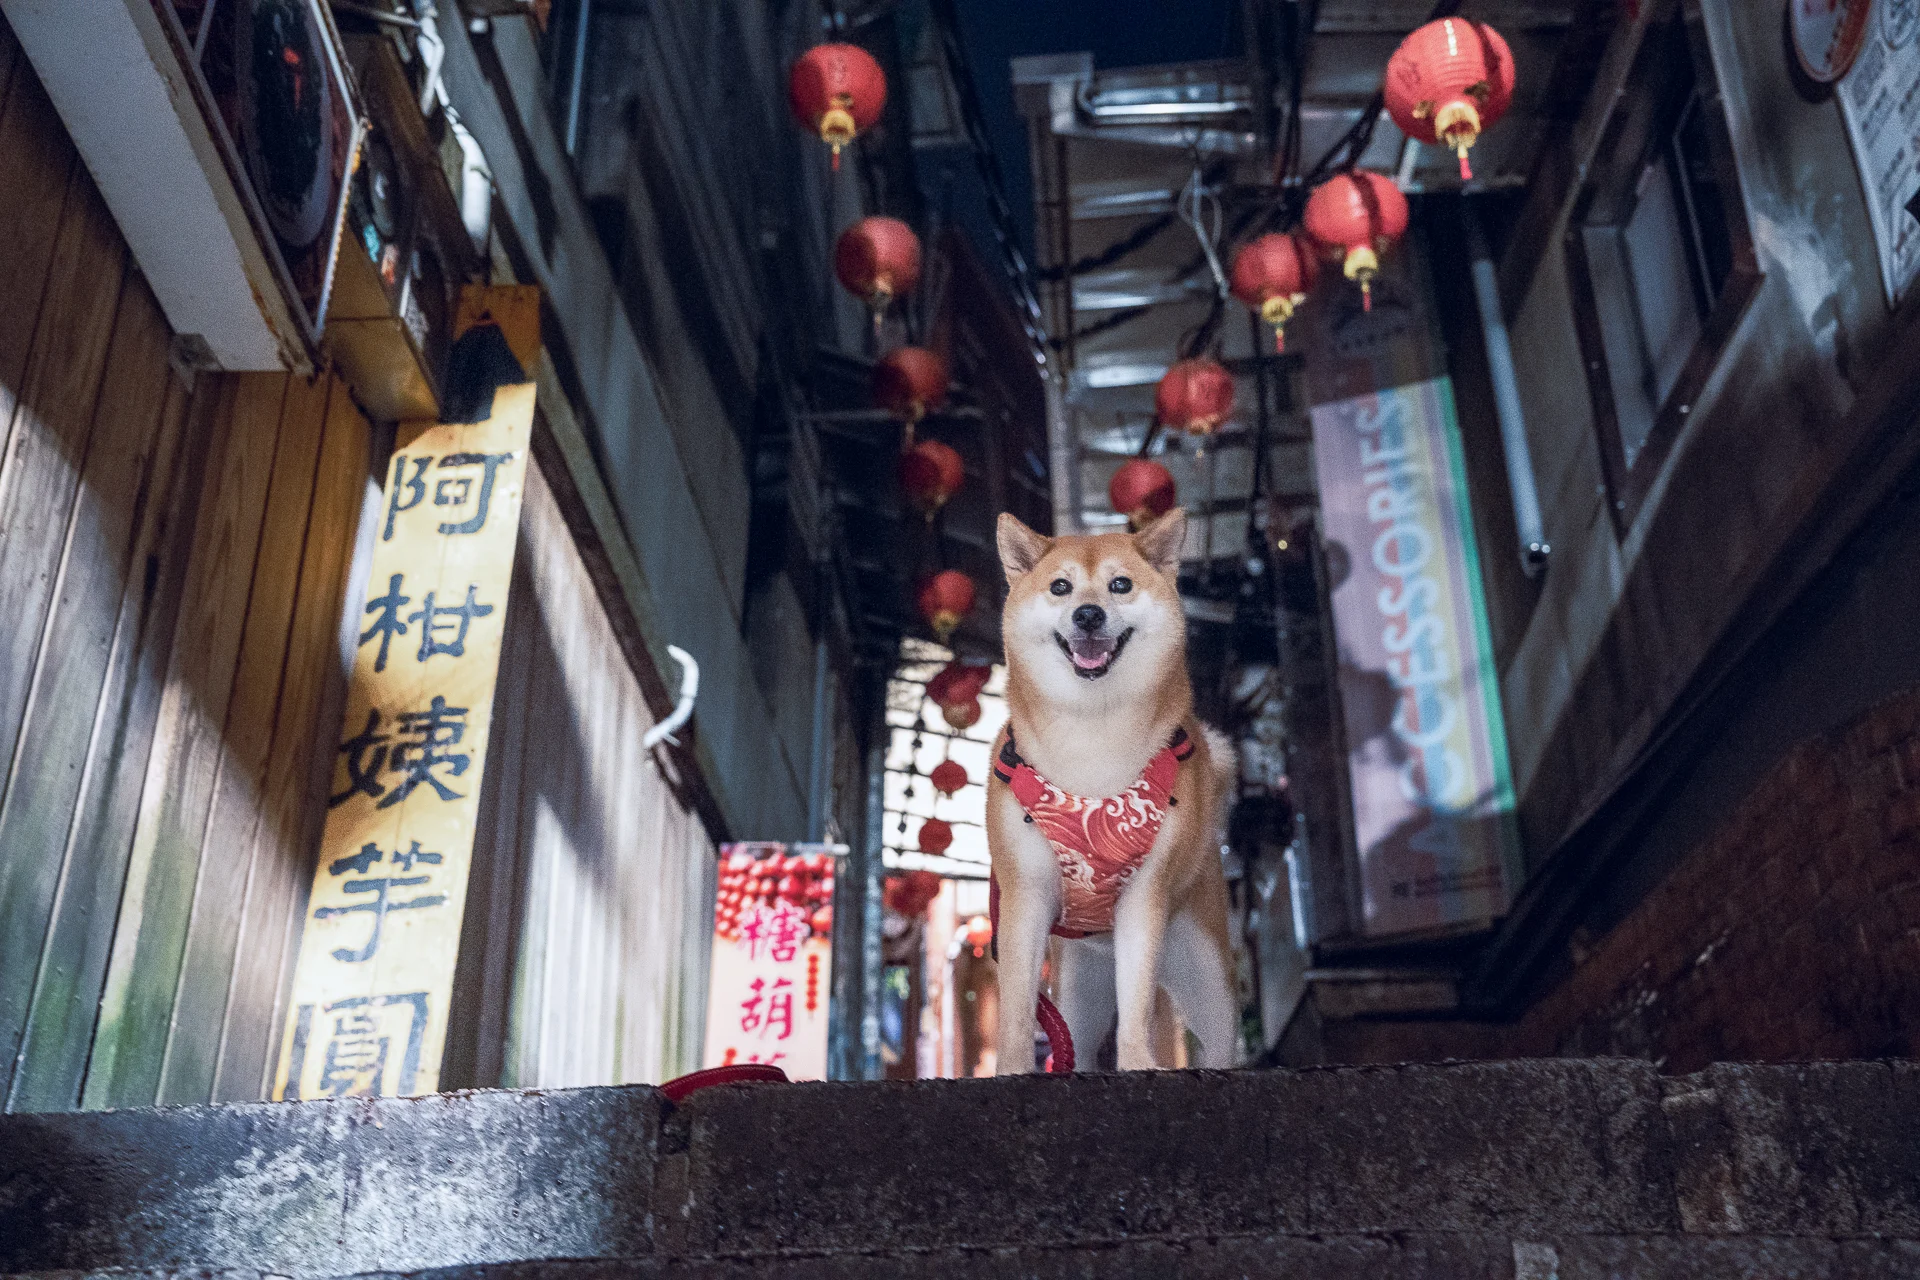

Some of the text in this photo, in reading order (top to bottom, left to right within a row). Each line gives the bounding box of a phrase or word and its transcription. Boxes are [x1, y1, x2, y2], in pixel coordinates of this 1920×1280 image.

[282, 453, 516, 1098] 阿柑姨芋圓
[740, 904, 804, 1066] 糖葫
